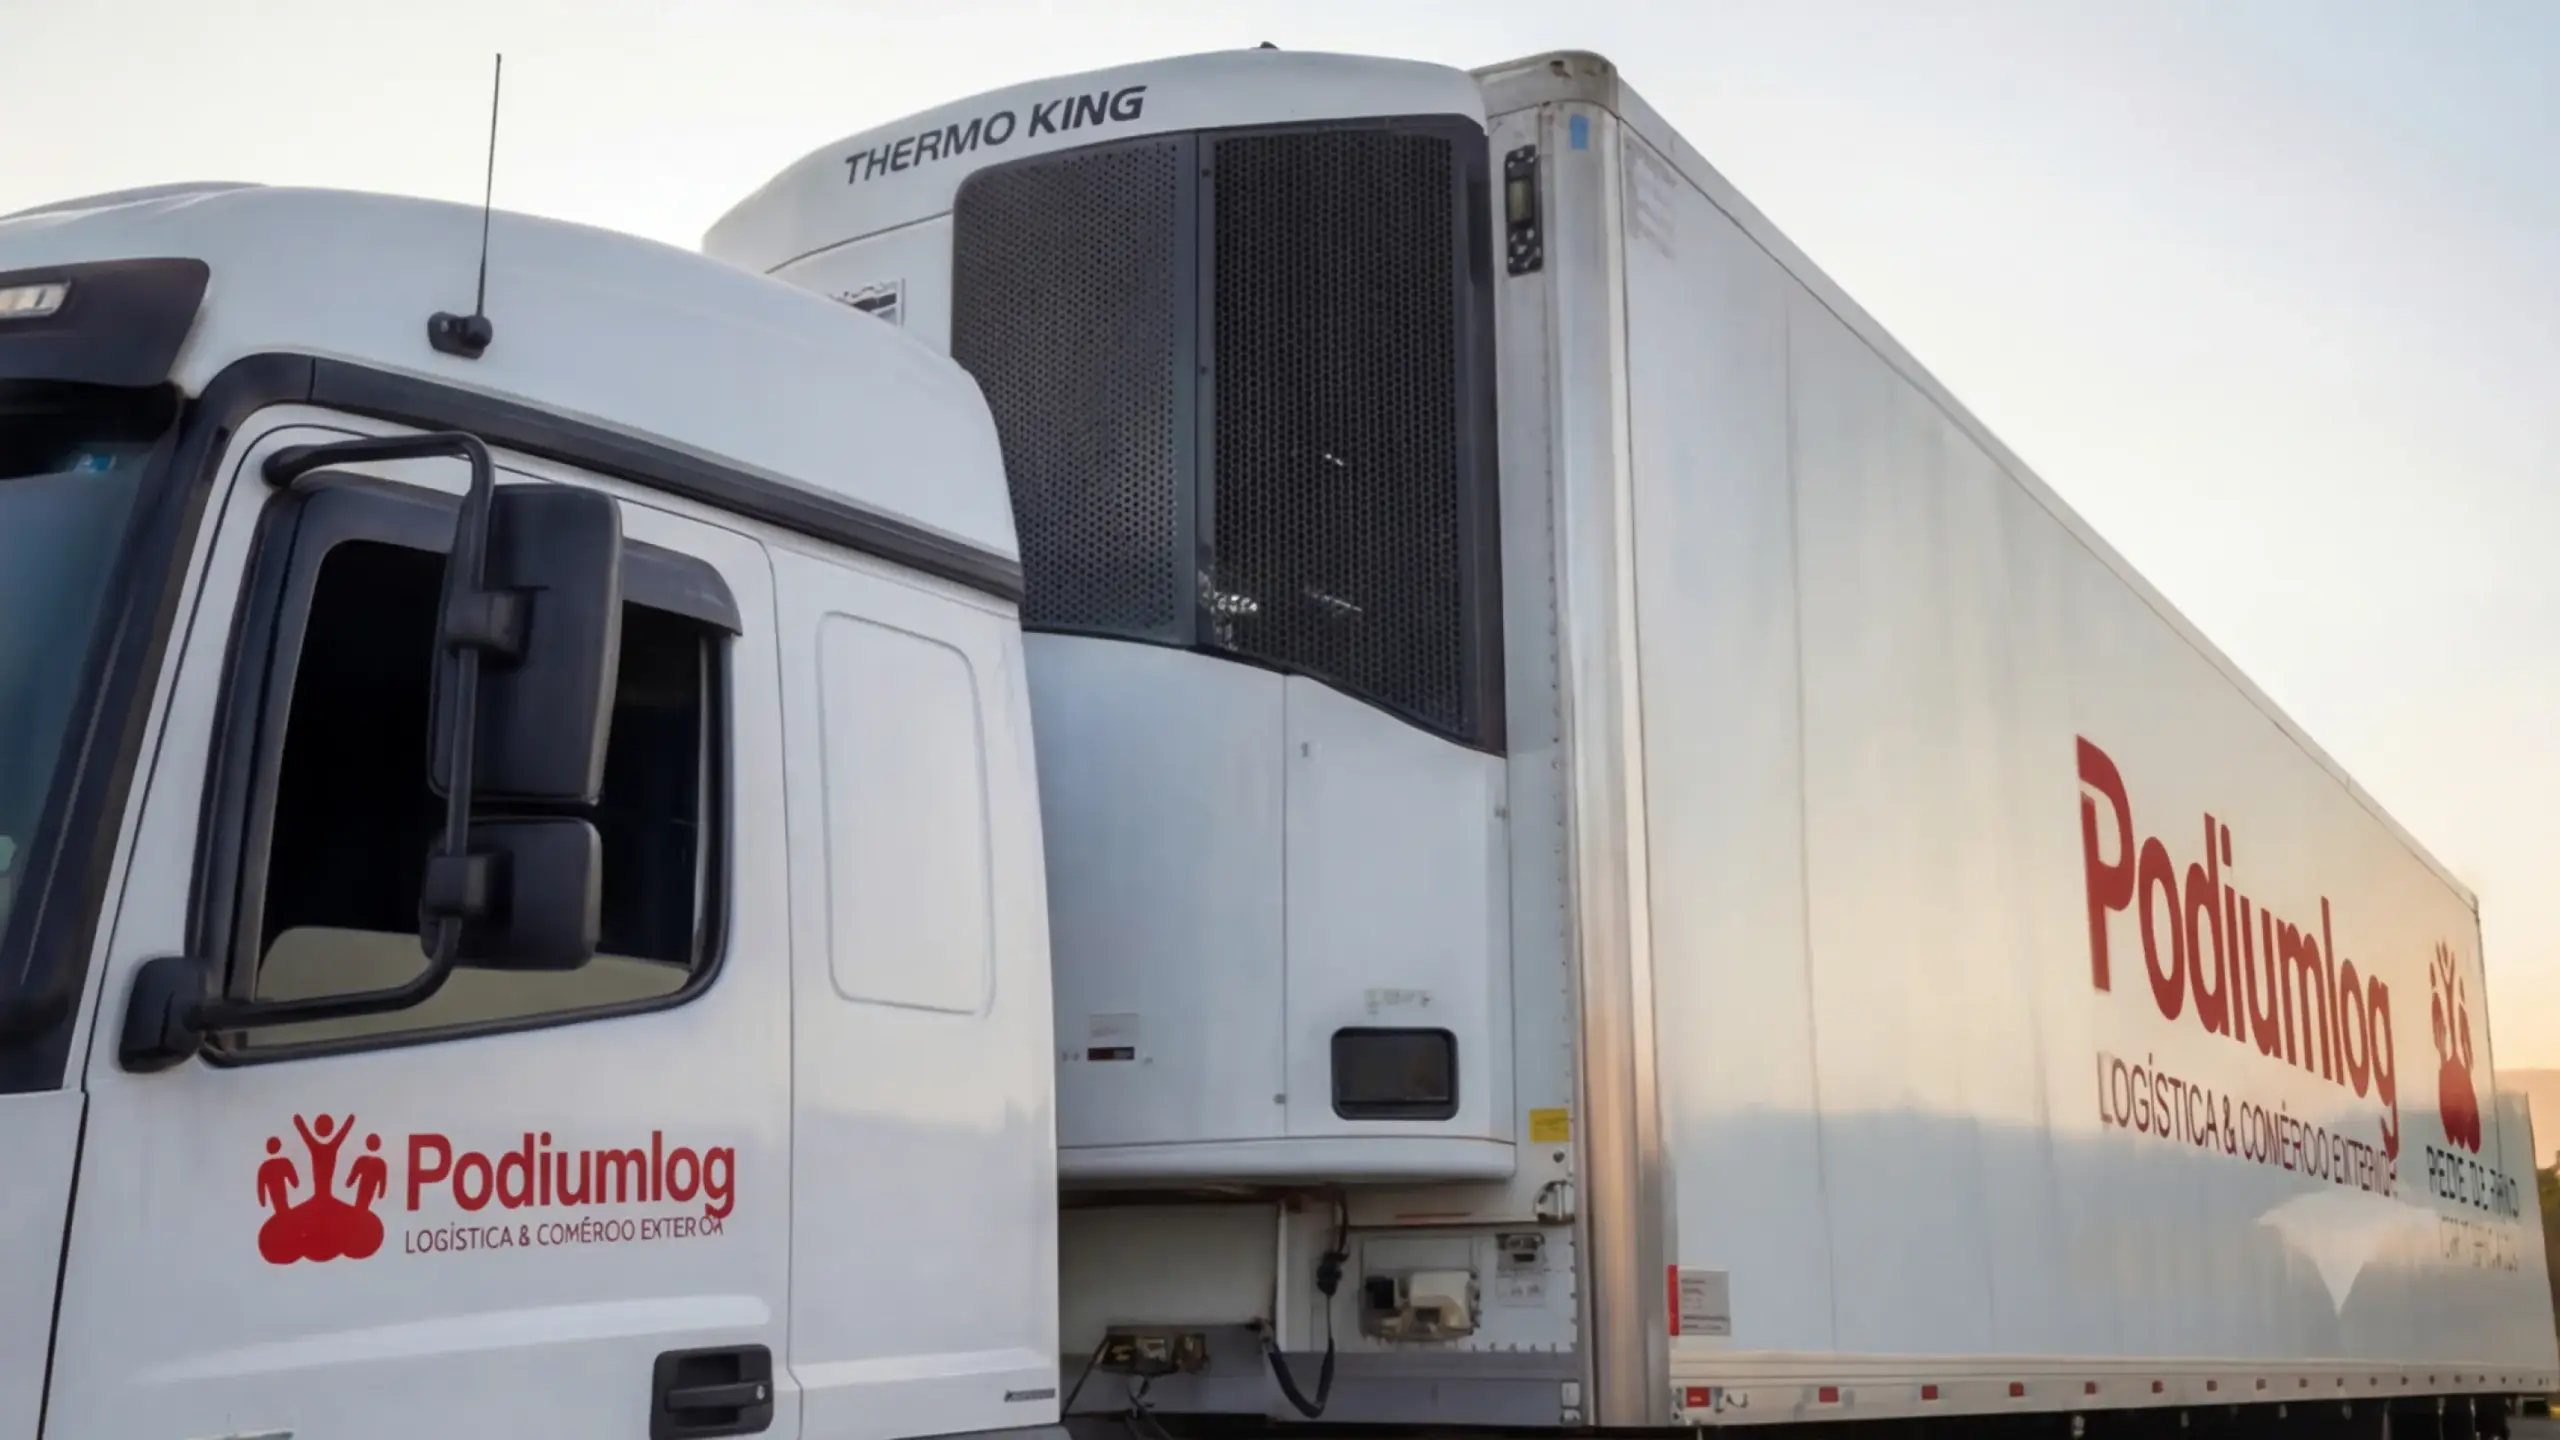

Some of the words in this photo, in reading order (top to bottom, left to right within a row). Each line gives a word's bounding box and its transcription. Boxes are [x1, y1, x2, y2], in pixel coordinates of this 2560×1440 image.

[845, 111, 1016, 185] THERMO
[1028, 85, 1147, 138] KING
[2076, 734, 2399, 1162] Podiumlog
[406, 1130, 735, 1218] Podiumlog
[518, 1224, 531, 1247] &
